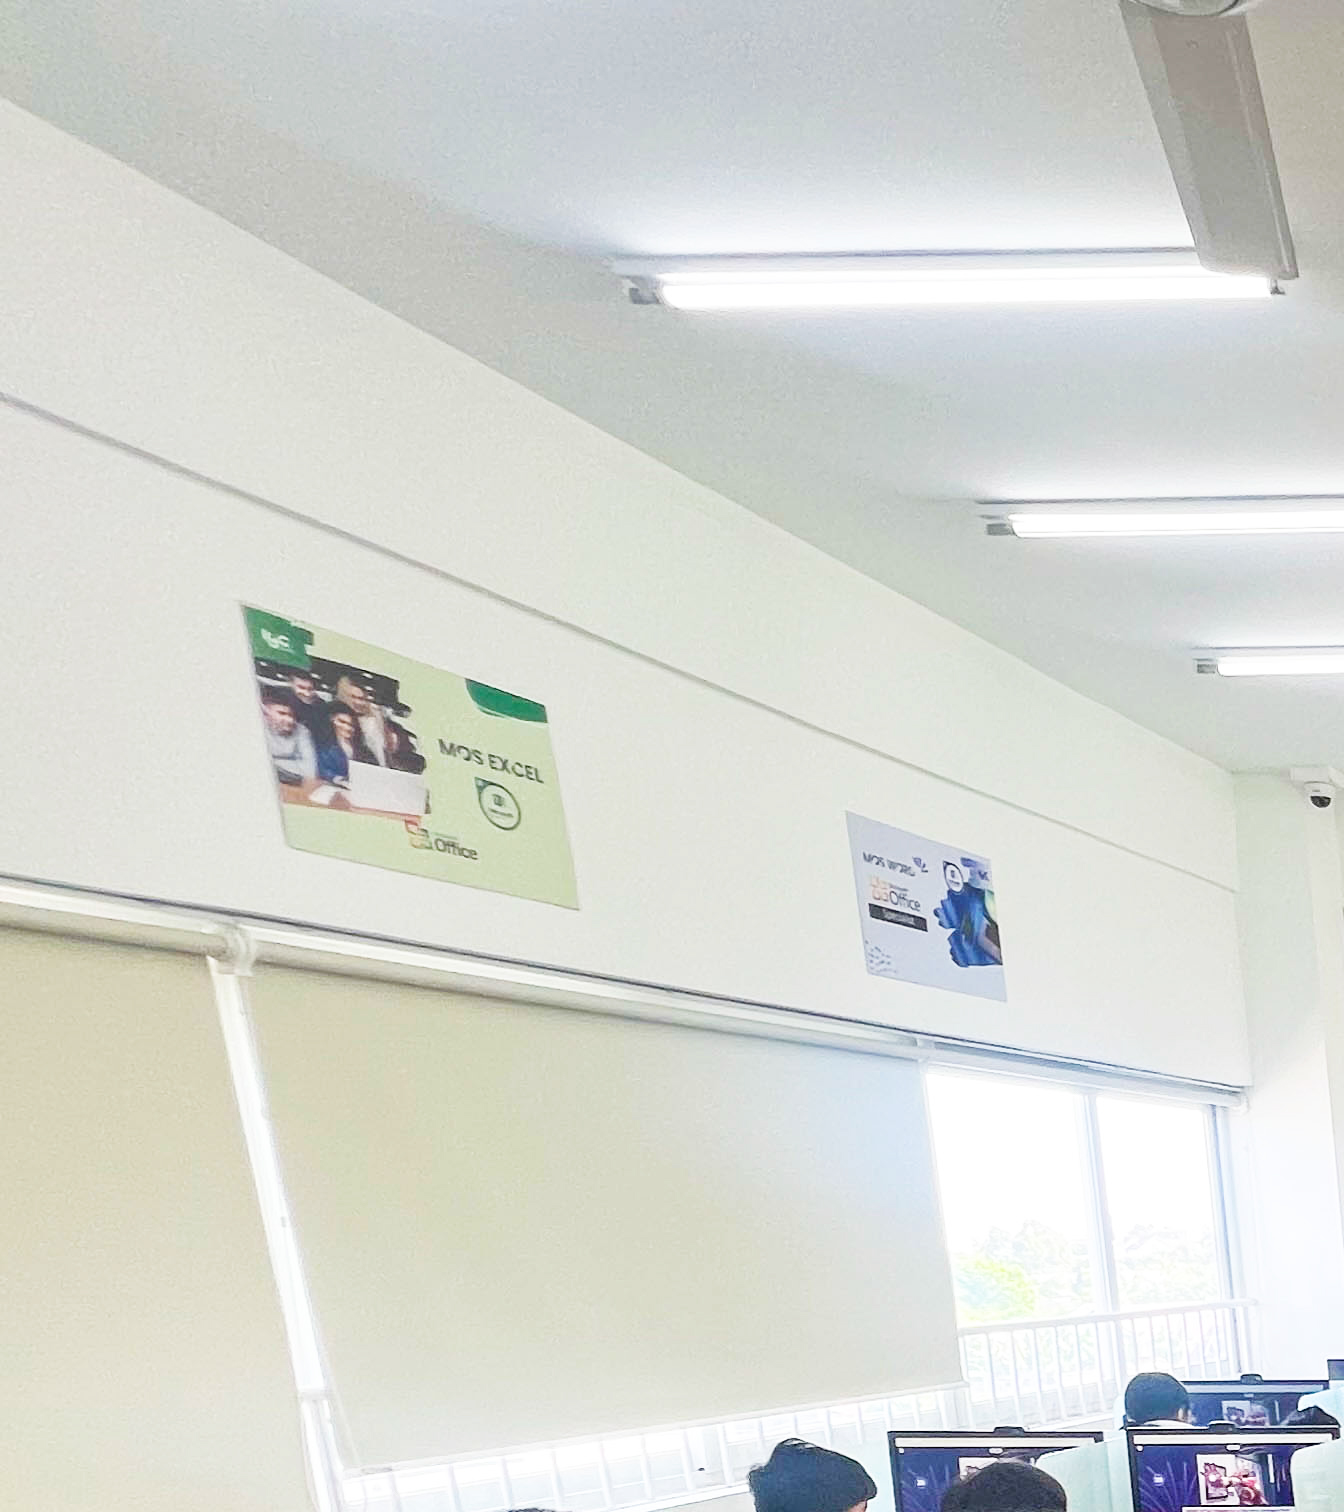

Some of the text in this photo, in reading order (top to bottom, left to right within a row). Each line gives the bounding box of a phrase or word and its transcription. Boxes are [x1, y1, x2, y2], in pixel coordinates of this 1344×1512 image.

[438, 738, 545, 784] MOS EXCEL
[434, 838, 479, 860] Office
[889, 890, 921, 912] Office
